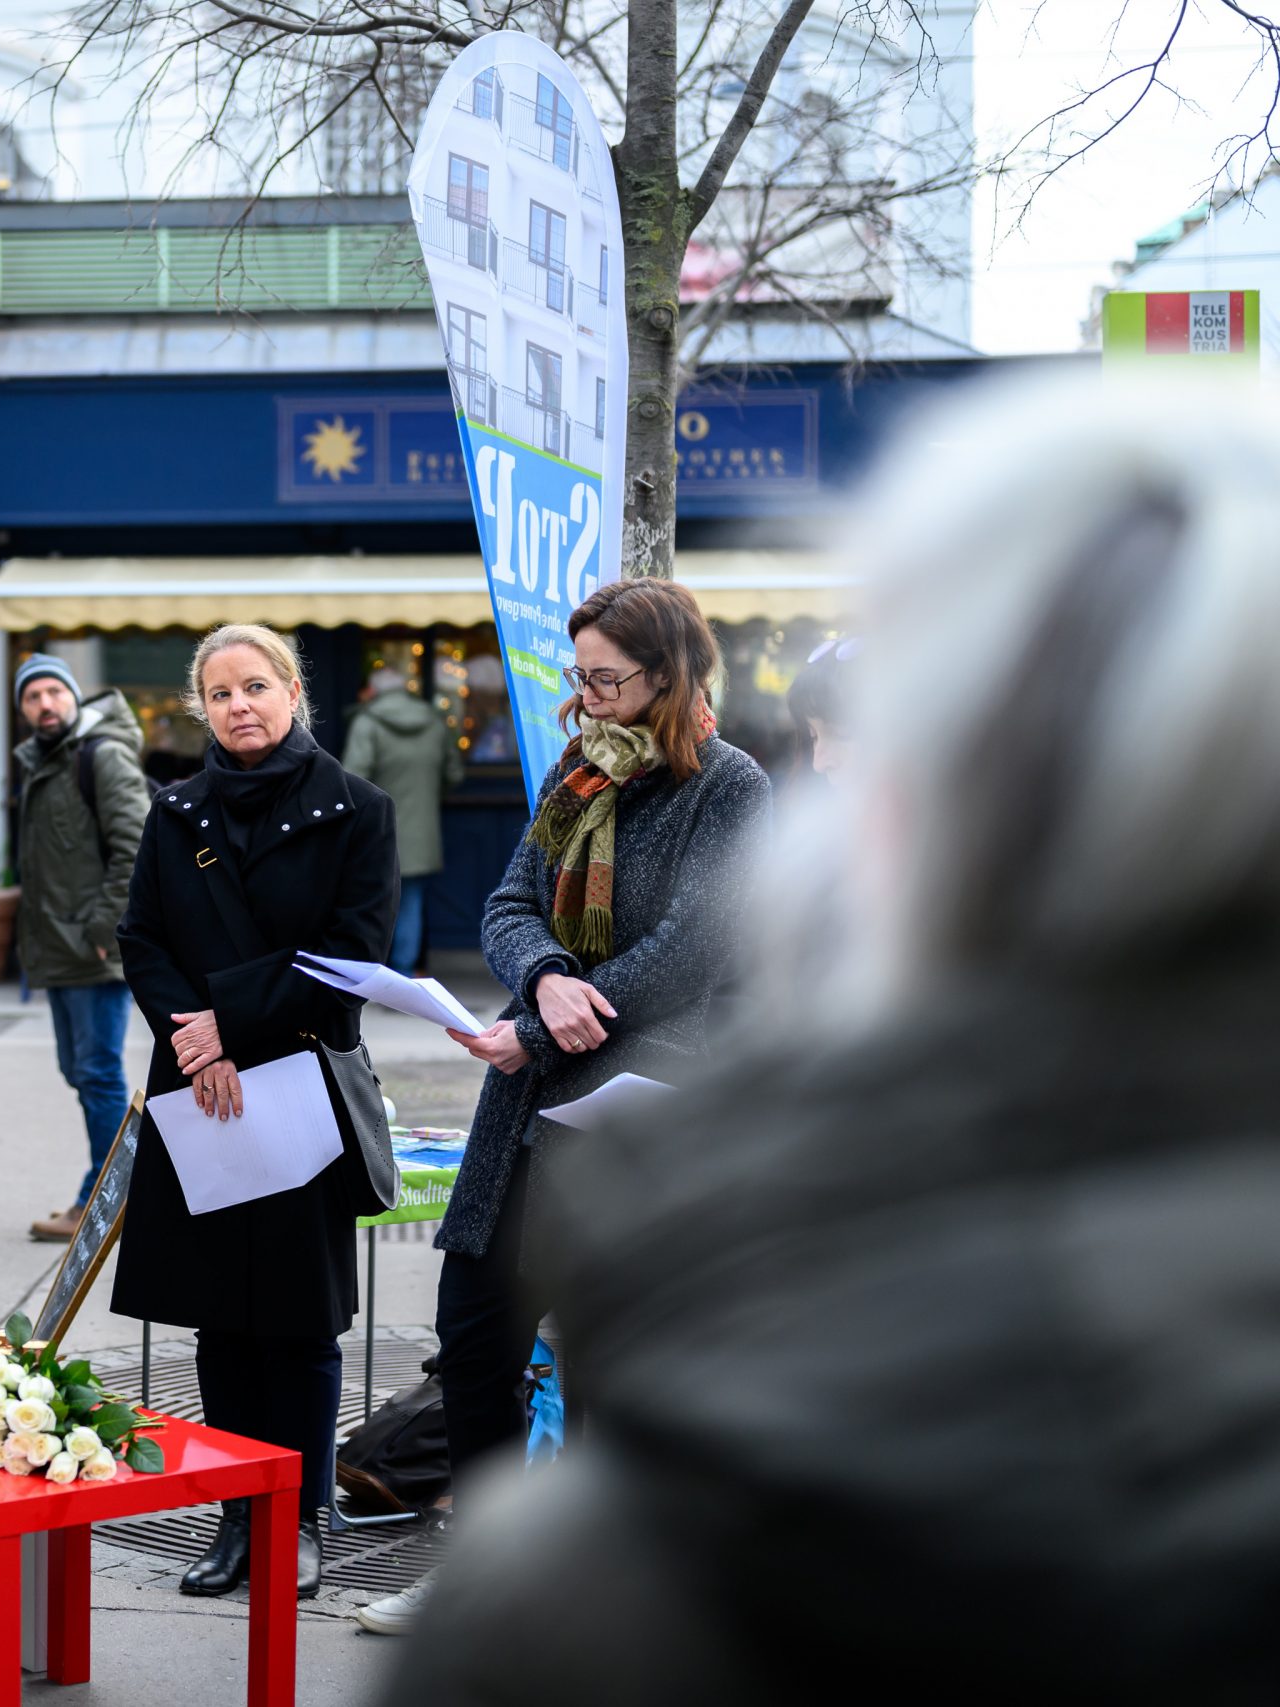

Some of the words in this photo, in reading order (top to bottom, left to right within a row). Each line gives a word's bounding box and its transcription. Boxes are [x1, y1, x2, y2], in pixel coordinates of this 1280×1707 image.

[1192, 304, 1227, 316] TELE
[1193, 317, 1227, 328] KOM
[1192, 329, 1227, 341] AUS
[1192, 341, 1227, 352] TRIA
[400, 1178, 455, 1207] Stadtte
